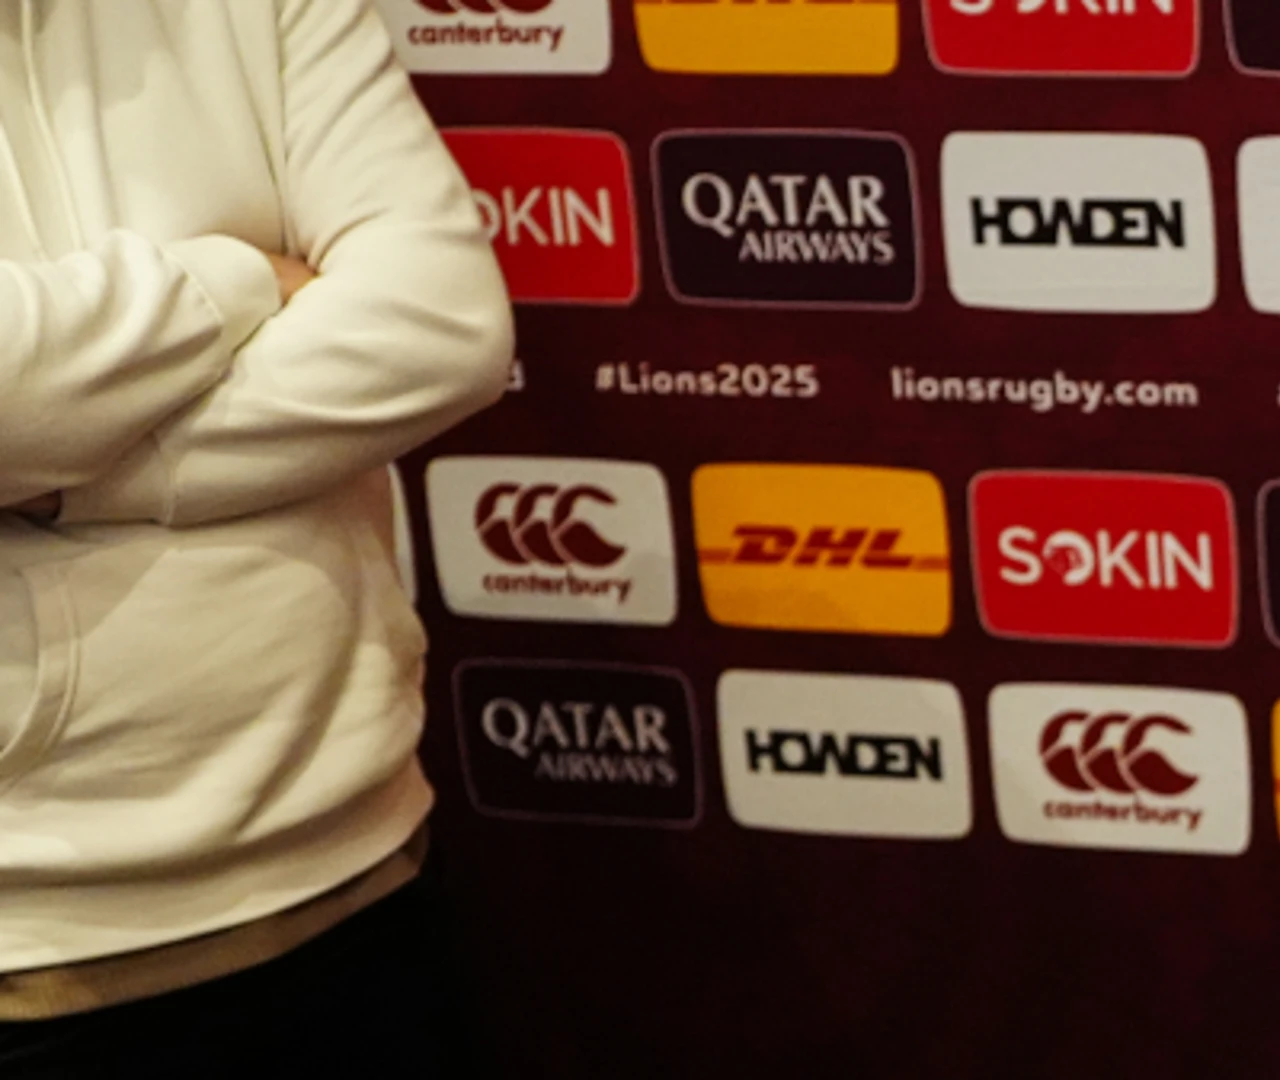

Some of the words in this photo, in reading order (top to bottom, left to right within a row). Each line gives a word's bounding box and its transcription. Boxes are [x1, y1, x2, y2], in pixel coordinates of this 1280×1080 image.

[407, 19, 565, 52] canterbury
[472, 186, 615, 246] OKIN
[681, 174, 889, 238] QATAR
[970, 197, 1186, 248] HOWDEN
[738, 231, 894, 265] AIRWAYS
[595, 364, 819, 397] #Lions2025
[891, 368, 1198, 412] lionsrugby.com
[730, 525, 914, 569] DHL
[999, 526, 1213, 590] SOKIN
[482, 571, 632, 603] canterbury
[481, 699, 669, 756] QATAR
[535, 750, 677, 786] AIRWAYS
[745, 729, 943, 780] HOWDEN
[1043, 800, 1203, 832] canterbury
